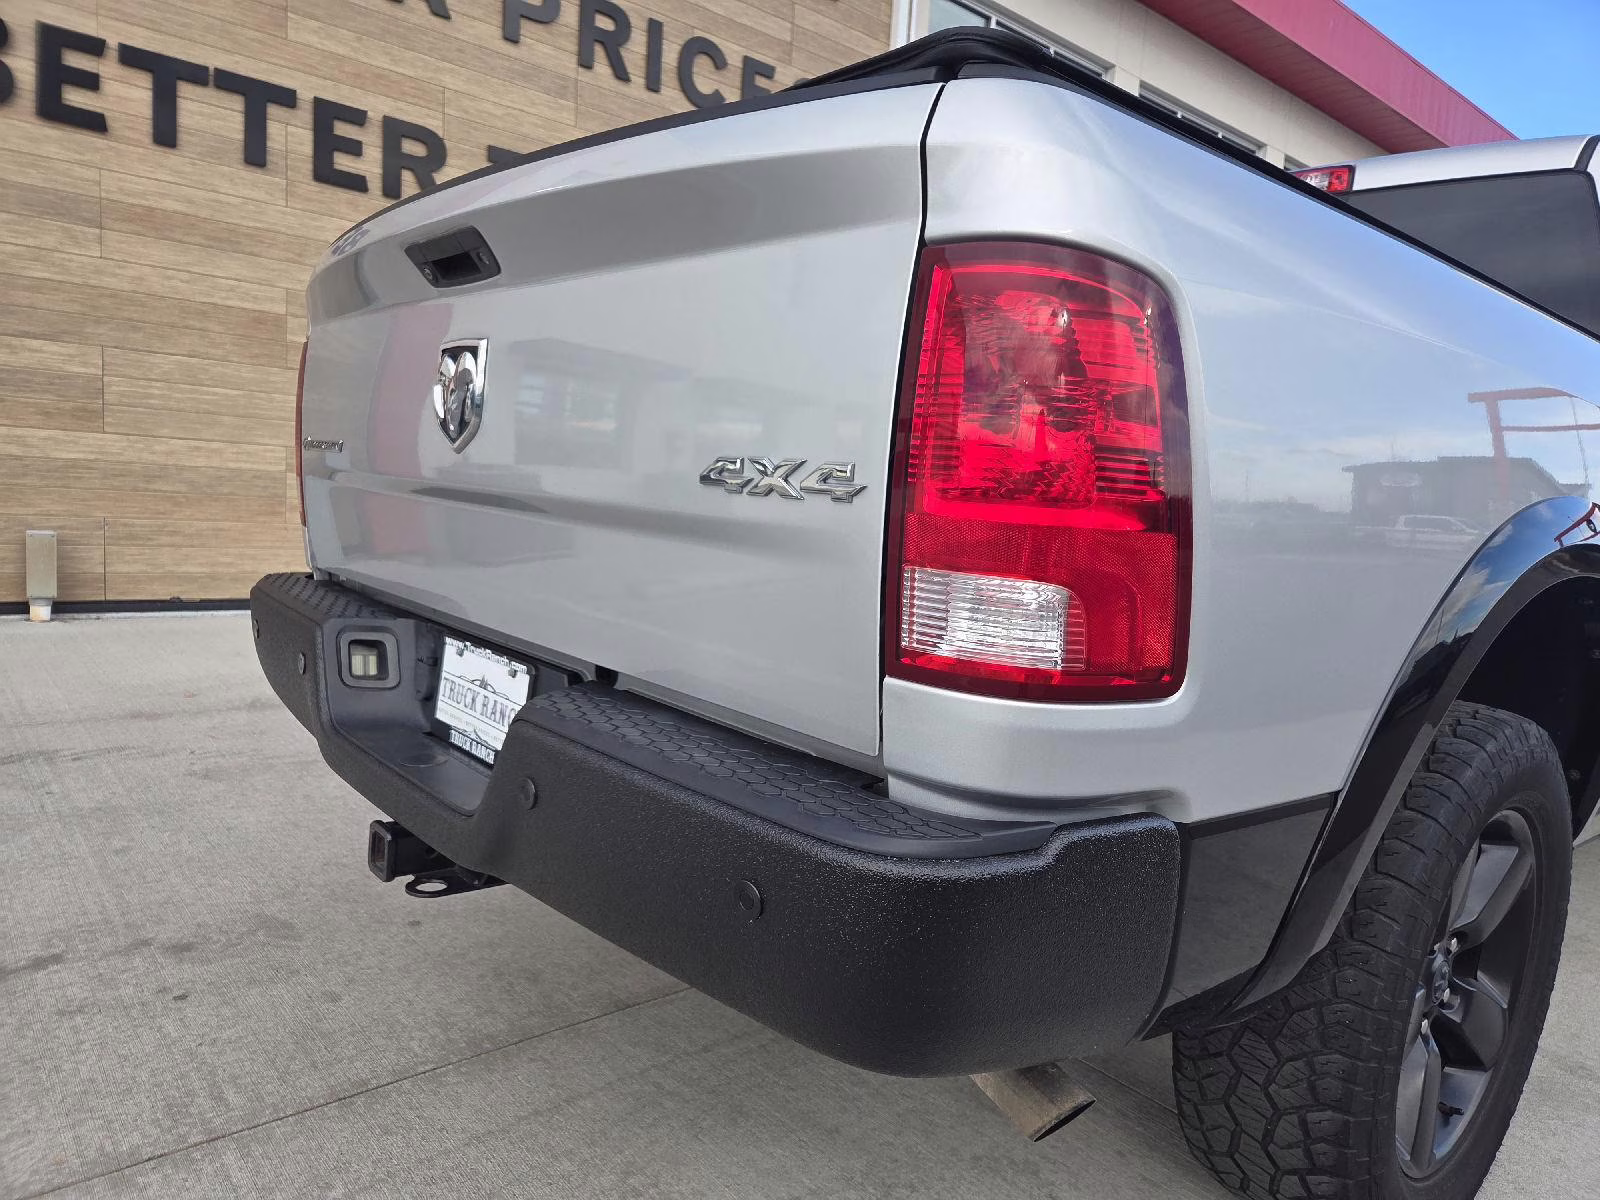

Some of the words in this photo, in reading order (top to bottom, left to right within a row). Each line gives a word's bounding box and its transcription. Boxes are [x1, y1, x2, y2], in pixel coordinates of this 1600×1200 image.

[503, 0, 811, 108] PRICE
[0, 18, 447, 199] ETTER
[442, 676, 480, 713] TRUCK
[449, 729, 473, 752] TRUCK
